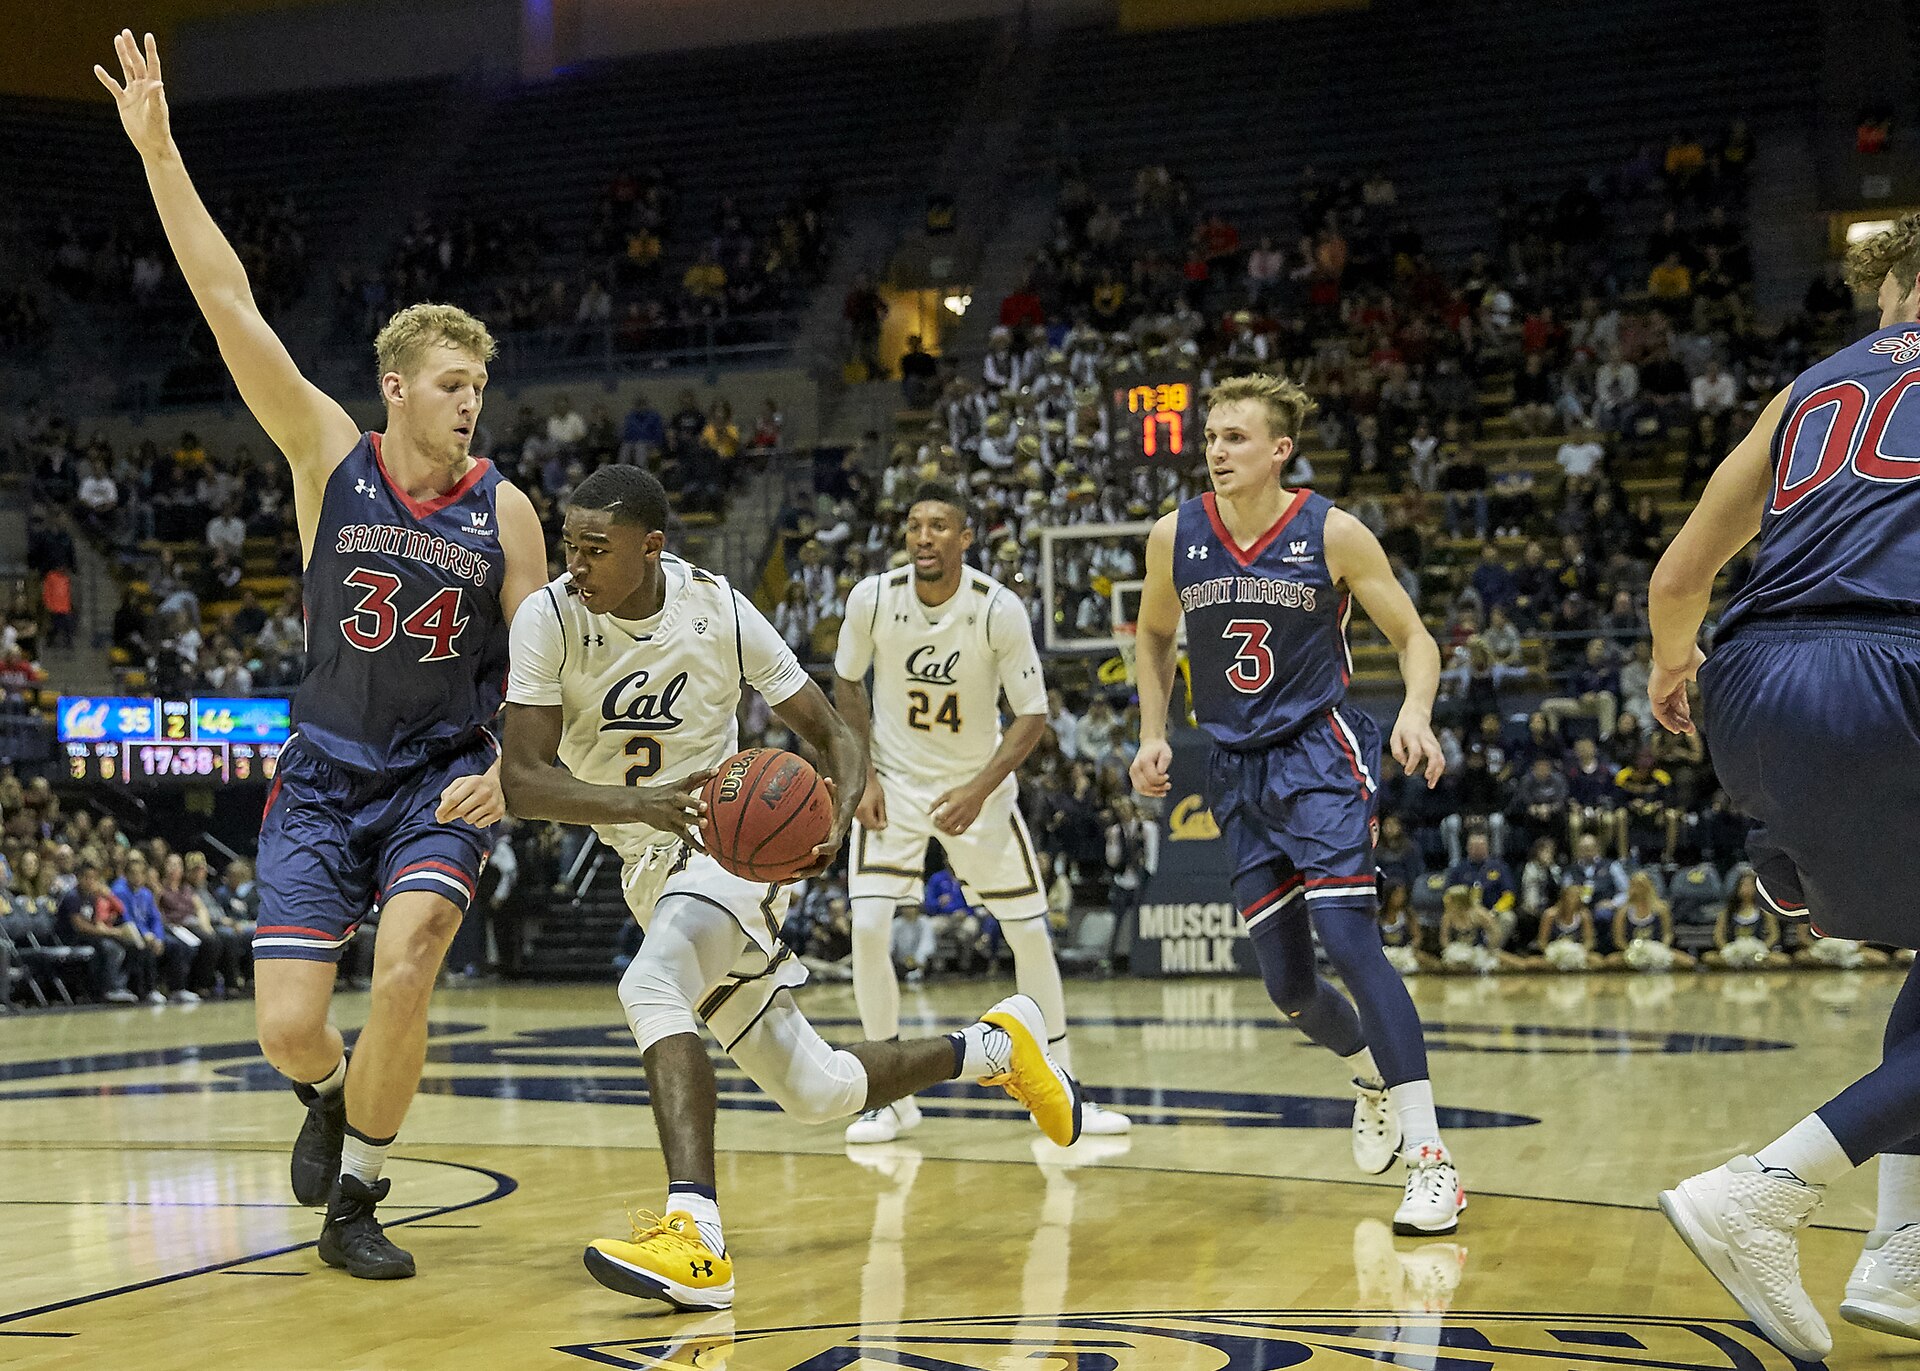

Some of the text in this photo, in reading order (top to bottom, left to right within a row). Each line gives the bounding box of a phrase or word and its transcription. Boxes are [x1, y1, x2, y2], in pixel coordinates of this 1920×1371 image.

[1128, 383, 1189, 413] 17:38
[1143, 411, 1183, 457] 17
[335, 523, 491, 588] SAINT MARY'S
[340, 566, 470, 663] 34
[1180, 576, 1317, 613] SAINT MARY'S
[905, 645, 961, 686] Cal
[1222, 618, 1275, 694] 3
[65, 699, 109, 739] Cal
[118, 706, 151, 734] 35
[600, 671, 689, 732] Cal
[907, 688, 963, 734] 24
[167, 715, 186, 738] 2
[69, 757, 86, 779] 3
[140, 746, 214, 775] 17:38
[622, 736, 663, 787] 2
[1161, 937, 1239, 973] MILK
